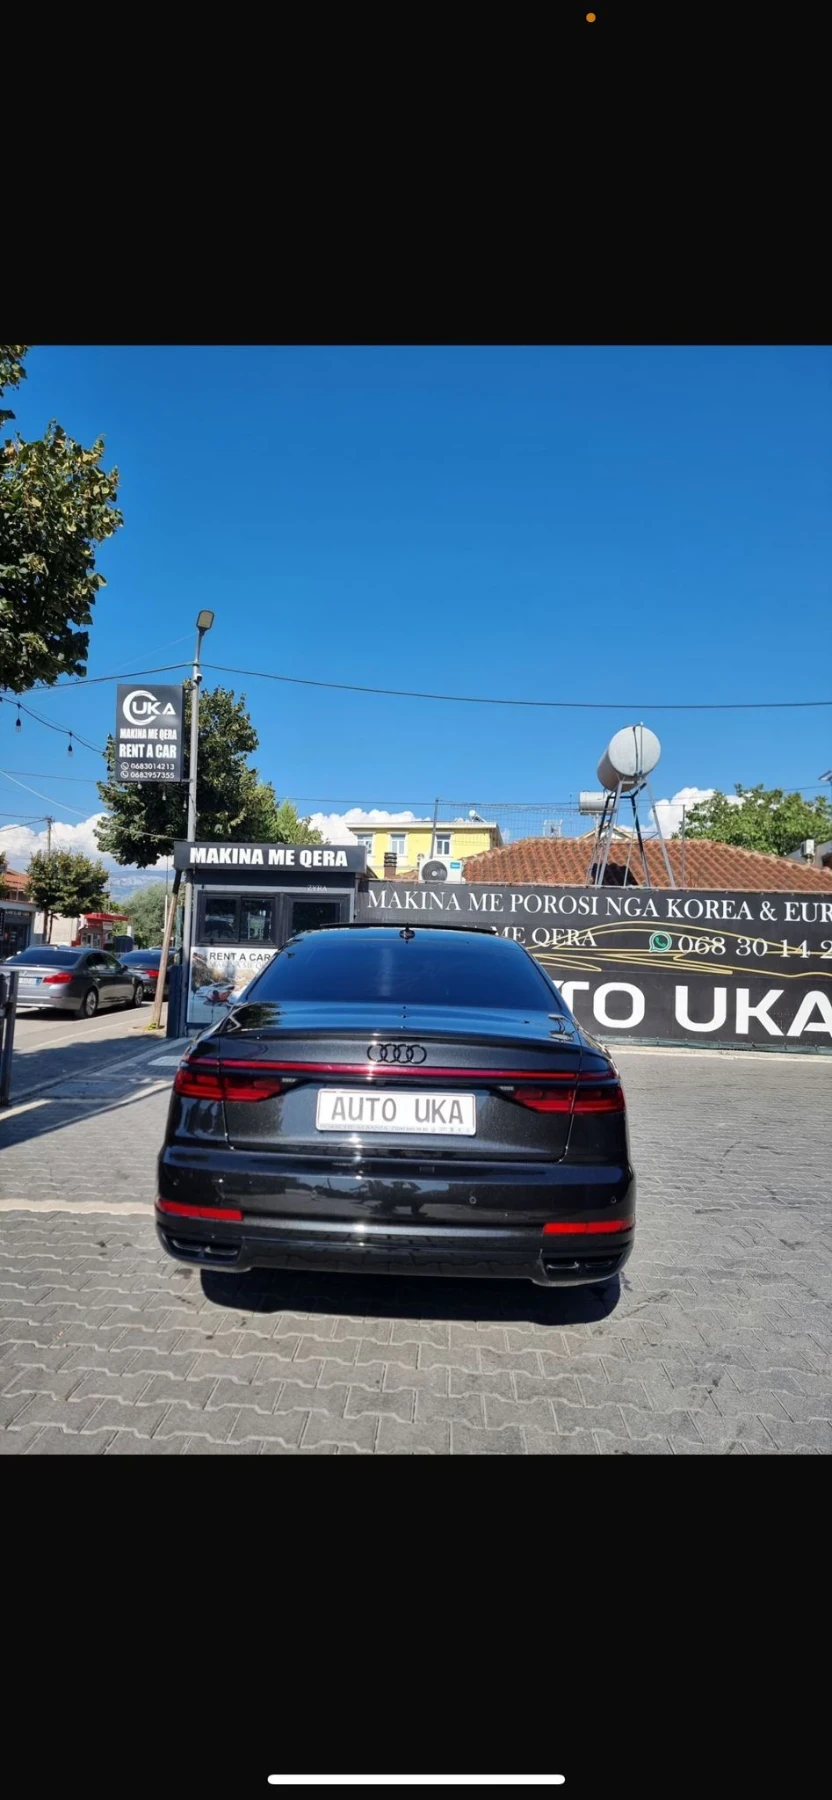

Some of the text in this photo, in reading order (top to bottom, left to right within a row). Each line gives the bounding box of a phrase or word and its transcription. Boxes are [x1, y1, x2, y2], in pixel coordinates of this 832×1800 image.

[120, 728, 177, 741] MAKINA ME QERA
[119, 743, 176, 758] RENT A CAR
[190, 847, 348, 868] MAKINA ME QERA
[367, 890, 832, 923] MAKINA ME POROSI NGA KOREA & EUR
[532, 927, 598, 947] QERA
[678, 936, 726, 955] 068
[736, 938, 768, 956] 30
[780, 939, 810, 959] 14
[209, 952, 270, 961] RENT A CAR
[675, 985, 832, 1037] UKA
[331, 1096, 464, 1124] AUTO UKA
